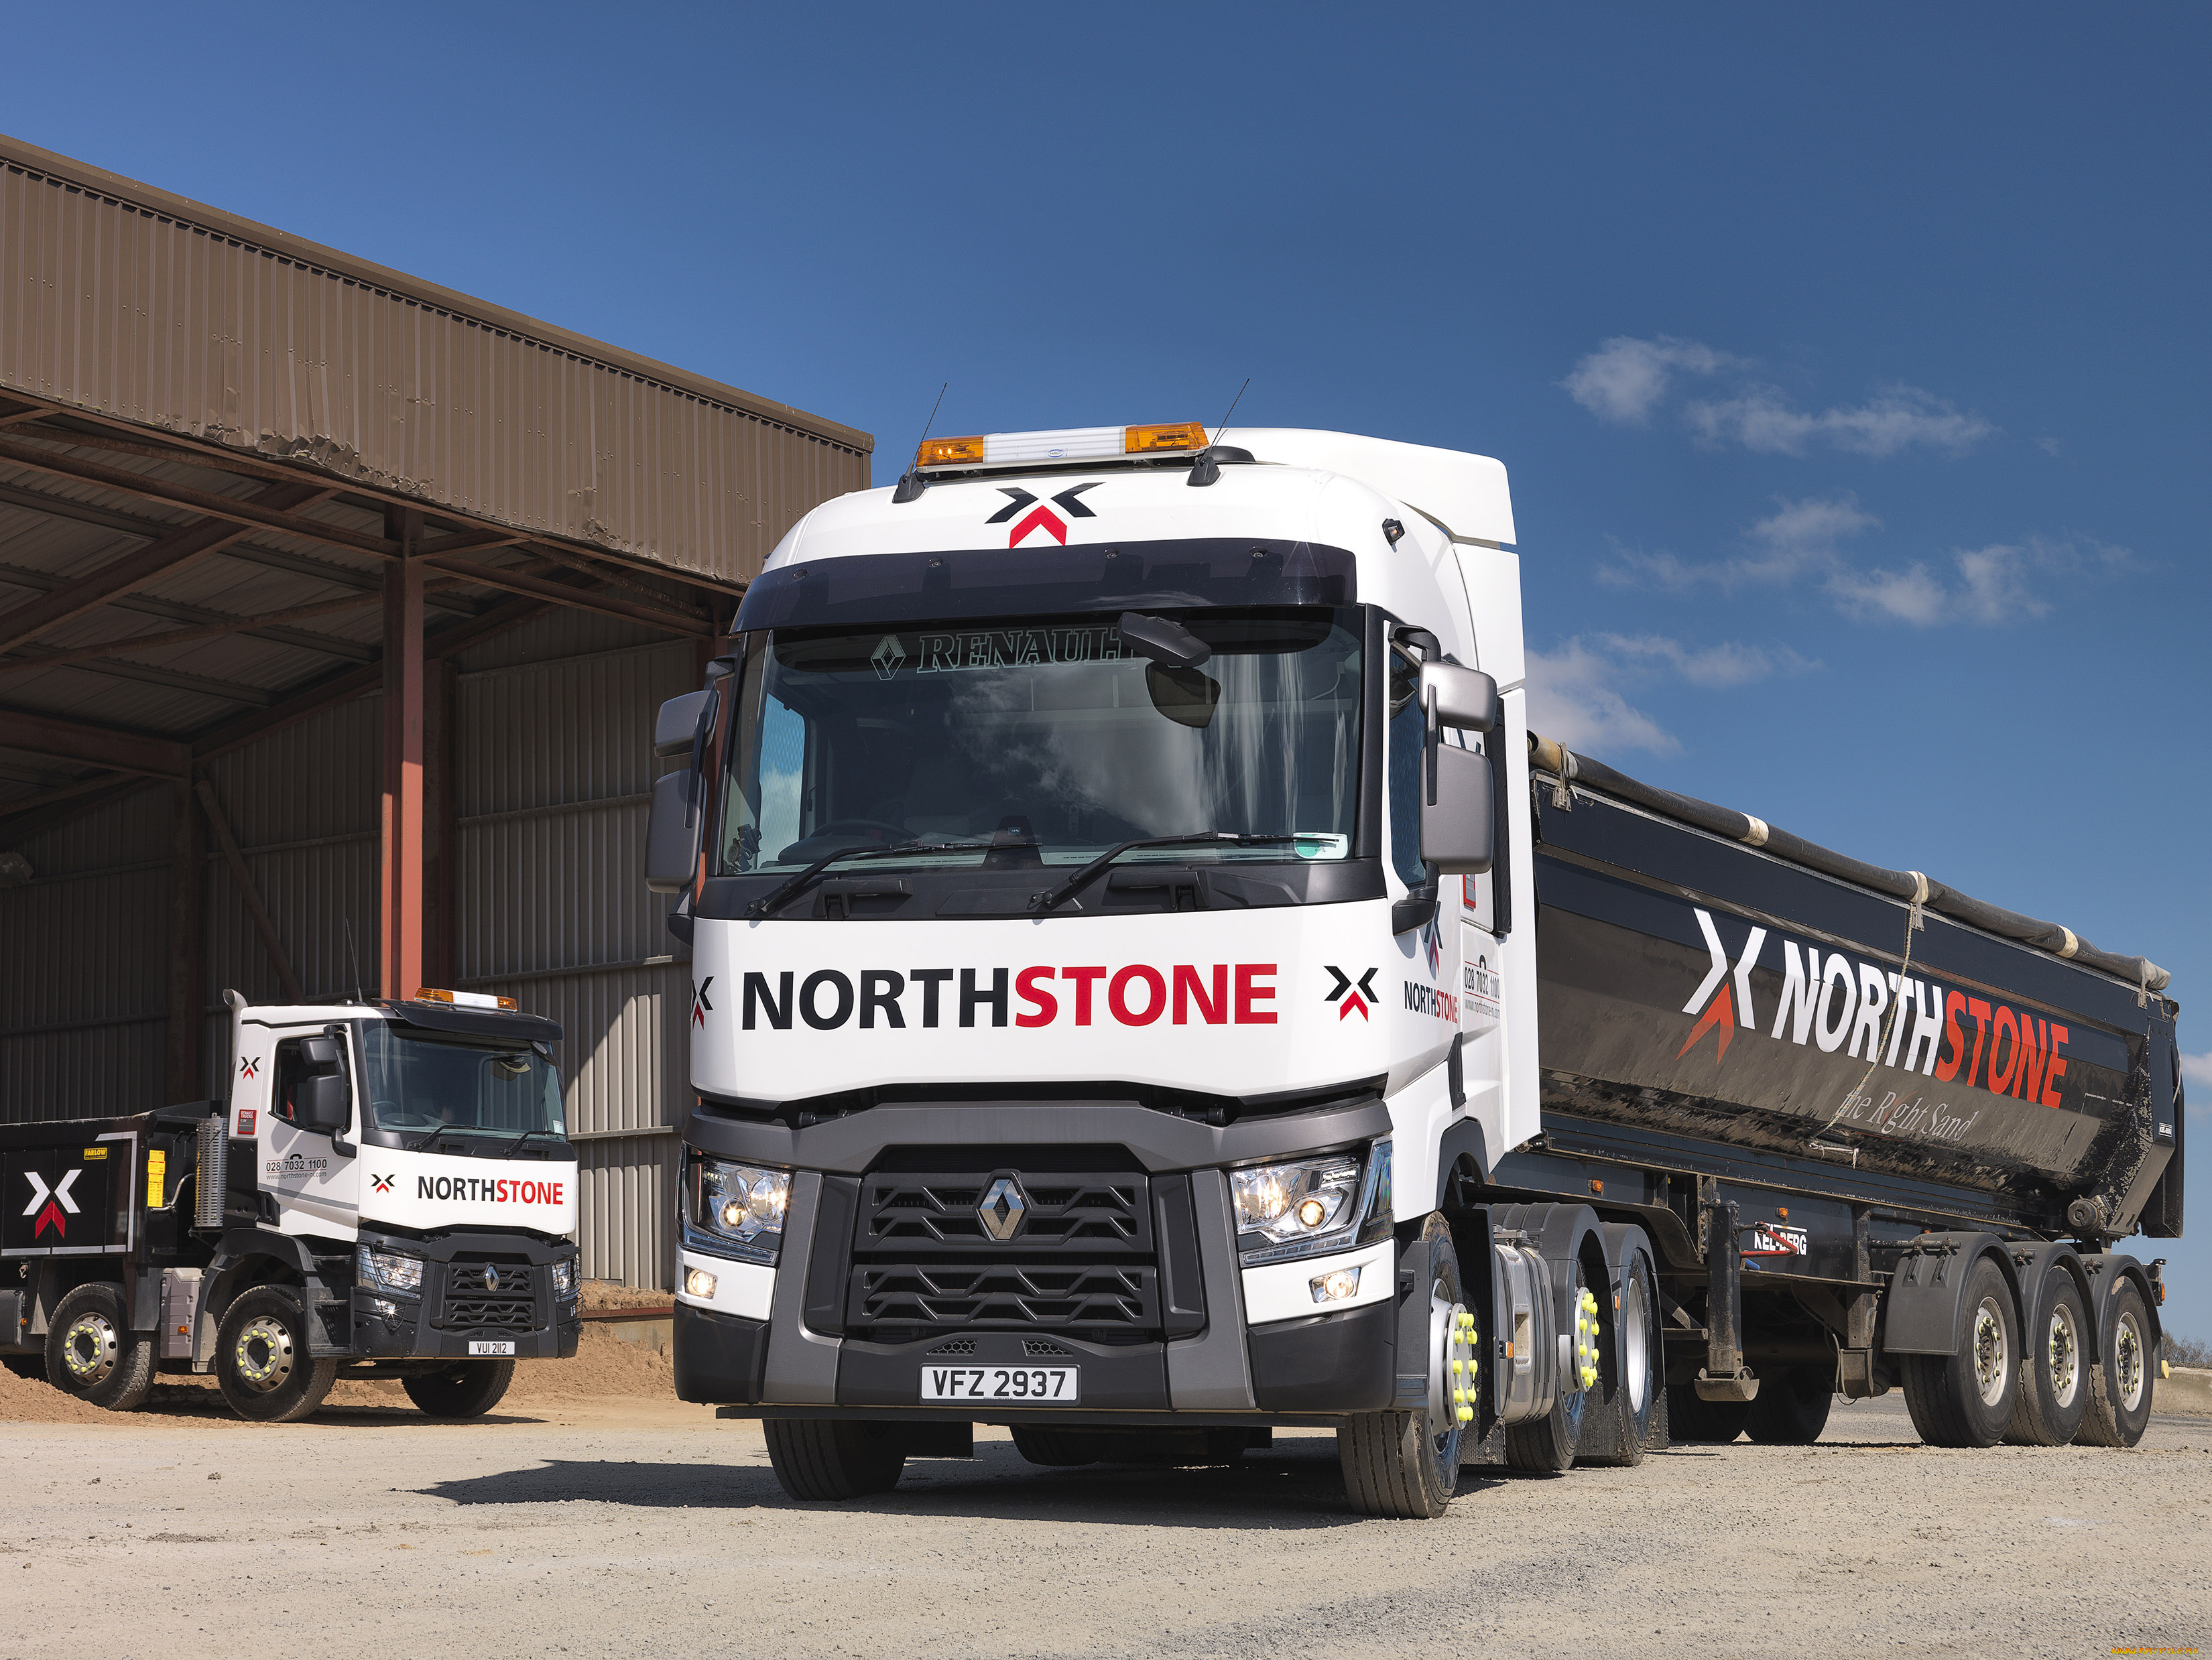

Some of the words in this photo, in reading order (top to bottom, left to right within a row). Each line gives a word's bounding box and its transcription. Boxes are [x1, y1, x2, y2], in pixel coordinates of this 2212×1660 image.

[741, 963, 1278, 1031] NORTHSTONE
[1465, 966, 1475, 991] 028
[1477, 971, 1489, 995] 7032
[1490, 975, 1499, 999] 1100
[1404, 980, 1457, 1024] NORTHSTONE
[1770, 939, 2069, 1109] NORTHSTONE
[1835, 1084, 1872, 1120] the
[1866, 1090, 1930, 1135] Right
[1920, 1102, 1979, 1141] Sand
[266, 1162, 281, 1171] 028
[285, 1160, 304, 1170] 7032
[308, 1159, 327, 1169] 1100
[266, 1171, 326, 1179] www.northstone-ni.com
[418, 1176, 563, 1205] NORTHSTONE
[477, 1343, 490, 1354] VUI
[492, 1343, 507, 1354] 2112
[932, 1370, 985, 1397] VFZ
[993, 1370, 1066, 1397] 2937
